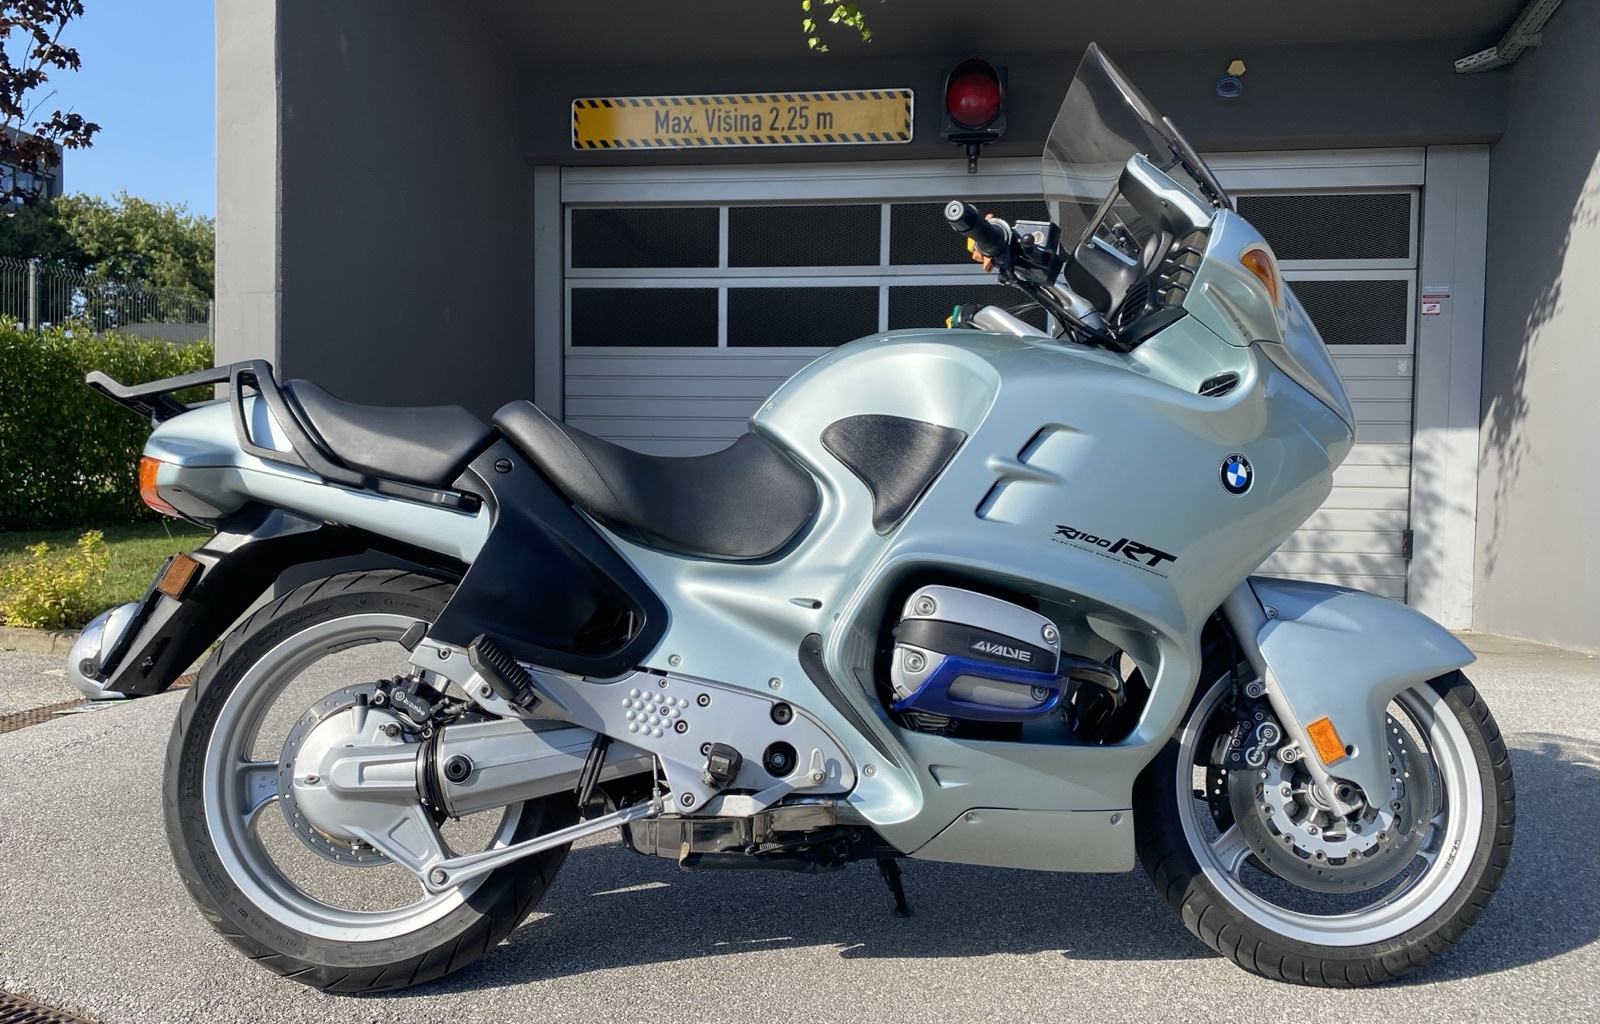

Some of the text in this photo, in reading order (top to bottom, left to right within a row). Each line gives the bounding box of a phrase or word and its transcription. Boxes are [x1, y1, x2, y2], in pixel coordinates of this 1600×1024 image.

[654, 105, 833, 135] Max. Višina 2,25 m
